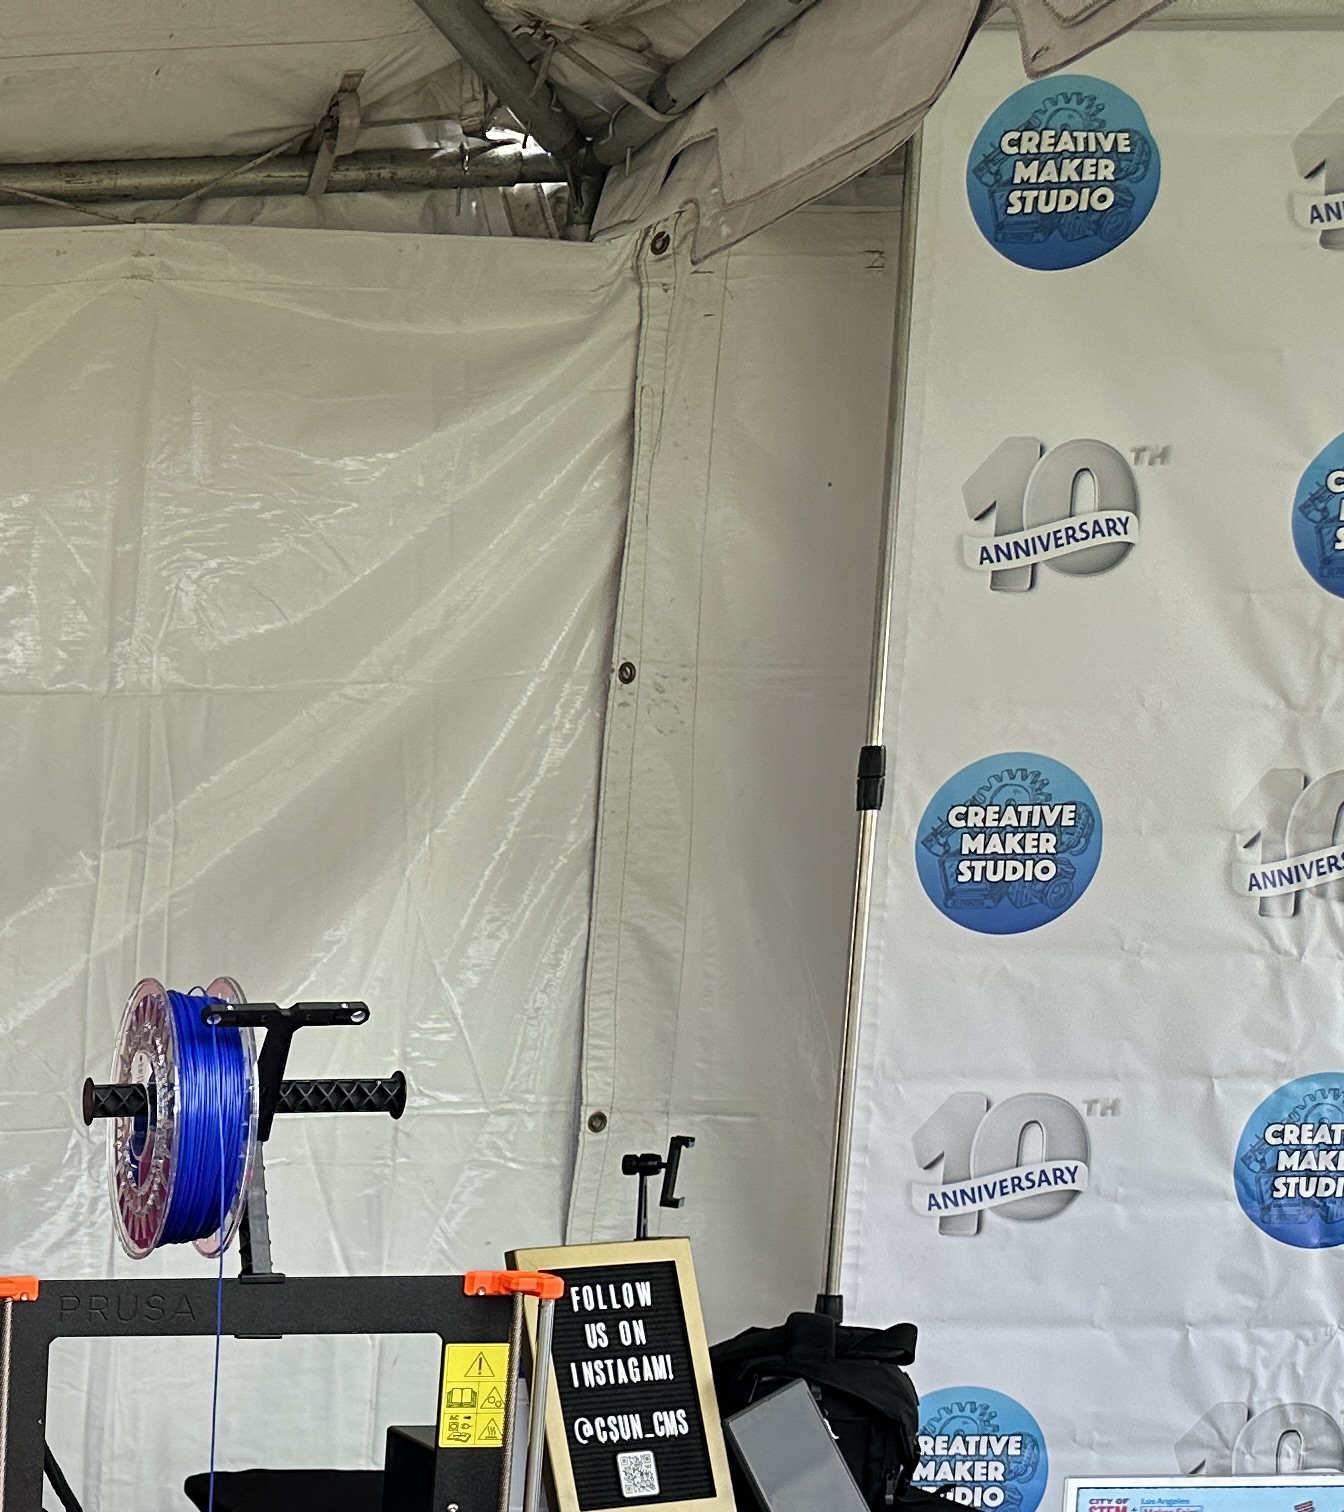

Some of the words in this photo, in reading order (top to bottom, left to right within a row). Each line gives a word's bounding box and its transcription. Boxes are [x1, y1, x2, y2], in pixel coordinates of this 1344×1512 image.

[999, 129, 1131, 155] CREATIVE
[1012, 157, 1115, 184] MAKER
[1006, 187, 1115, 214] STUDIO
[977, 515, 1131, 567] ANNIVERSARY
[947, 804, 1076, 828] CREATIVE
[961, 833, 1057, 855] MAKER
[957, 858, 1057, 883] STUDIO
[1264, 1123, 1344, 1146] CREAT
[926, 1166, 1079, 1213] ANNIVERSARY
[1272, 1176, 1344, 1198] STUDI
[60, 1293, 196, 1322] PRUSA
[570, 1281, 653, 1313] FOLLOW
[584, 1321, 610, 1349] US
[618, 1319, 647, 1347] ON
[573, 1408, 690, 1445] @CSUN_CMS
[918, 1435, 1023, 1456] REATIVE
[912, 1460, 1005, 1482] MAKER
